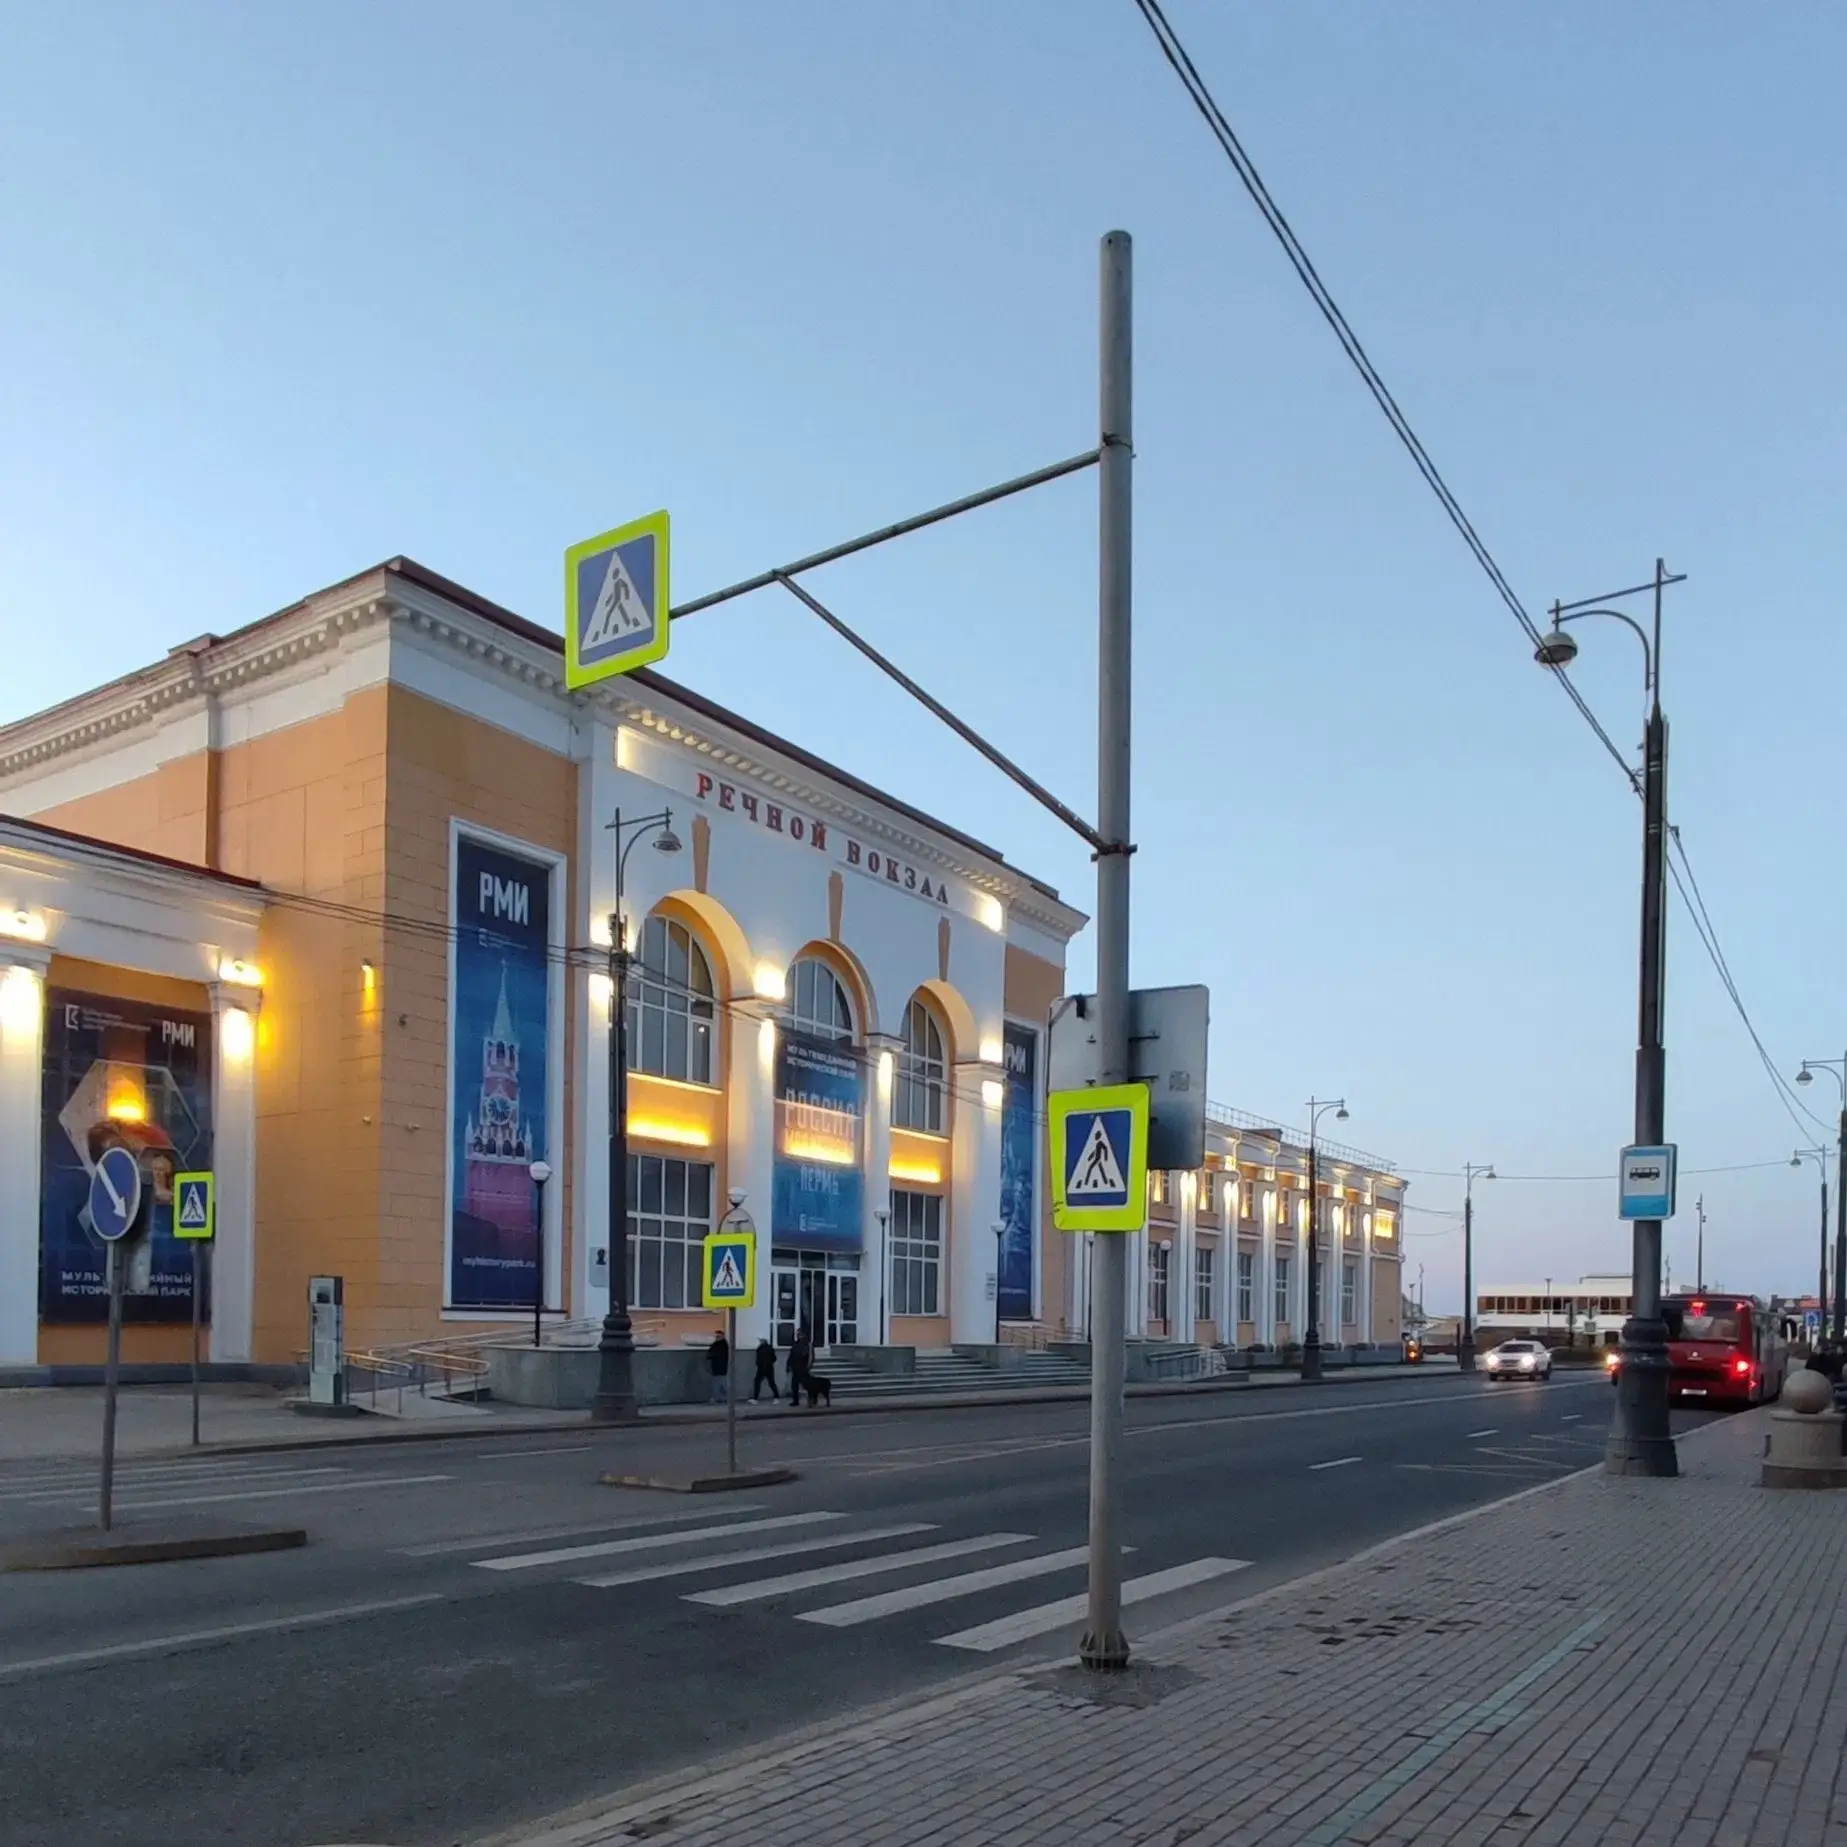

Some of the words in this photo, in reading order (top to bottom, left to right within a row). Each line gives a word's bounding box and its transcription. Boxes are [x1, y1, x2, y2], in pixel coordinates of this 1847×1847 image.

[697, 772, 828, 852] РЕЧНОЙ
[846, 839, 950, 905] ВОКЗАЛ
[479, 871, 529, 926] РМИ
[162, 1020, 195, 1048] РМИ
[784, 1086, 856, 1141] РОССИЯ
[800, 1163, 840, 1196] ПЕРМЬ
[160, 1286, 192, 1297] ПАРК
